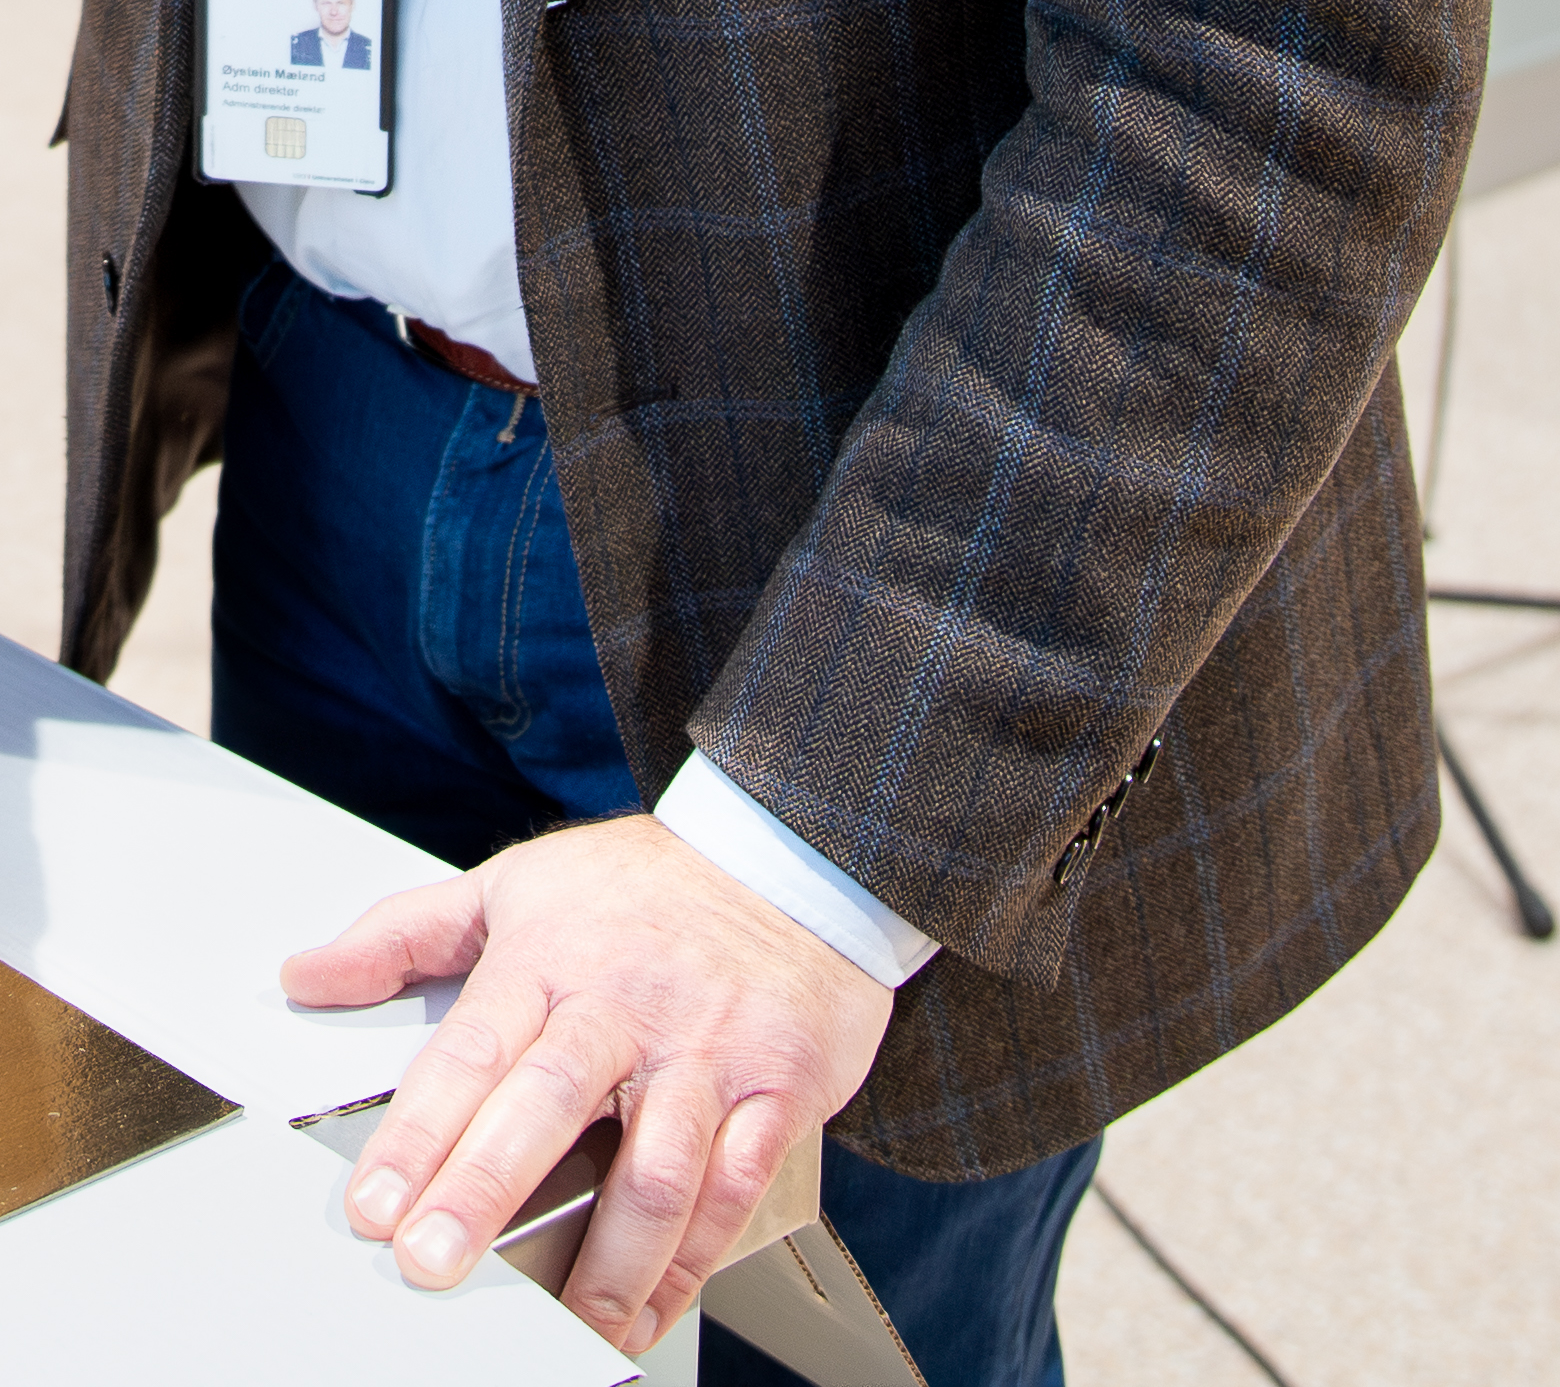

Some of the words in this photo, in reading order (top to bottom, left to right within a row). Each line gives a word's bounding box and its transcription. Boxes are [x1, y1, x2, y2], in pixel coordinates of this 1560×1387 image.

[222, 65, 271, 78] Øystein
[275, 68, 326, 82] Mæland
[222, 82, 251, 93] Adm
[254, 84, 300, 97] direktør
